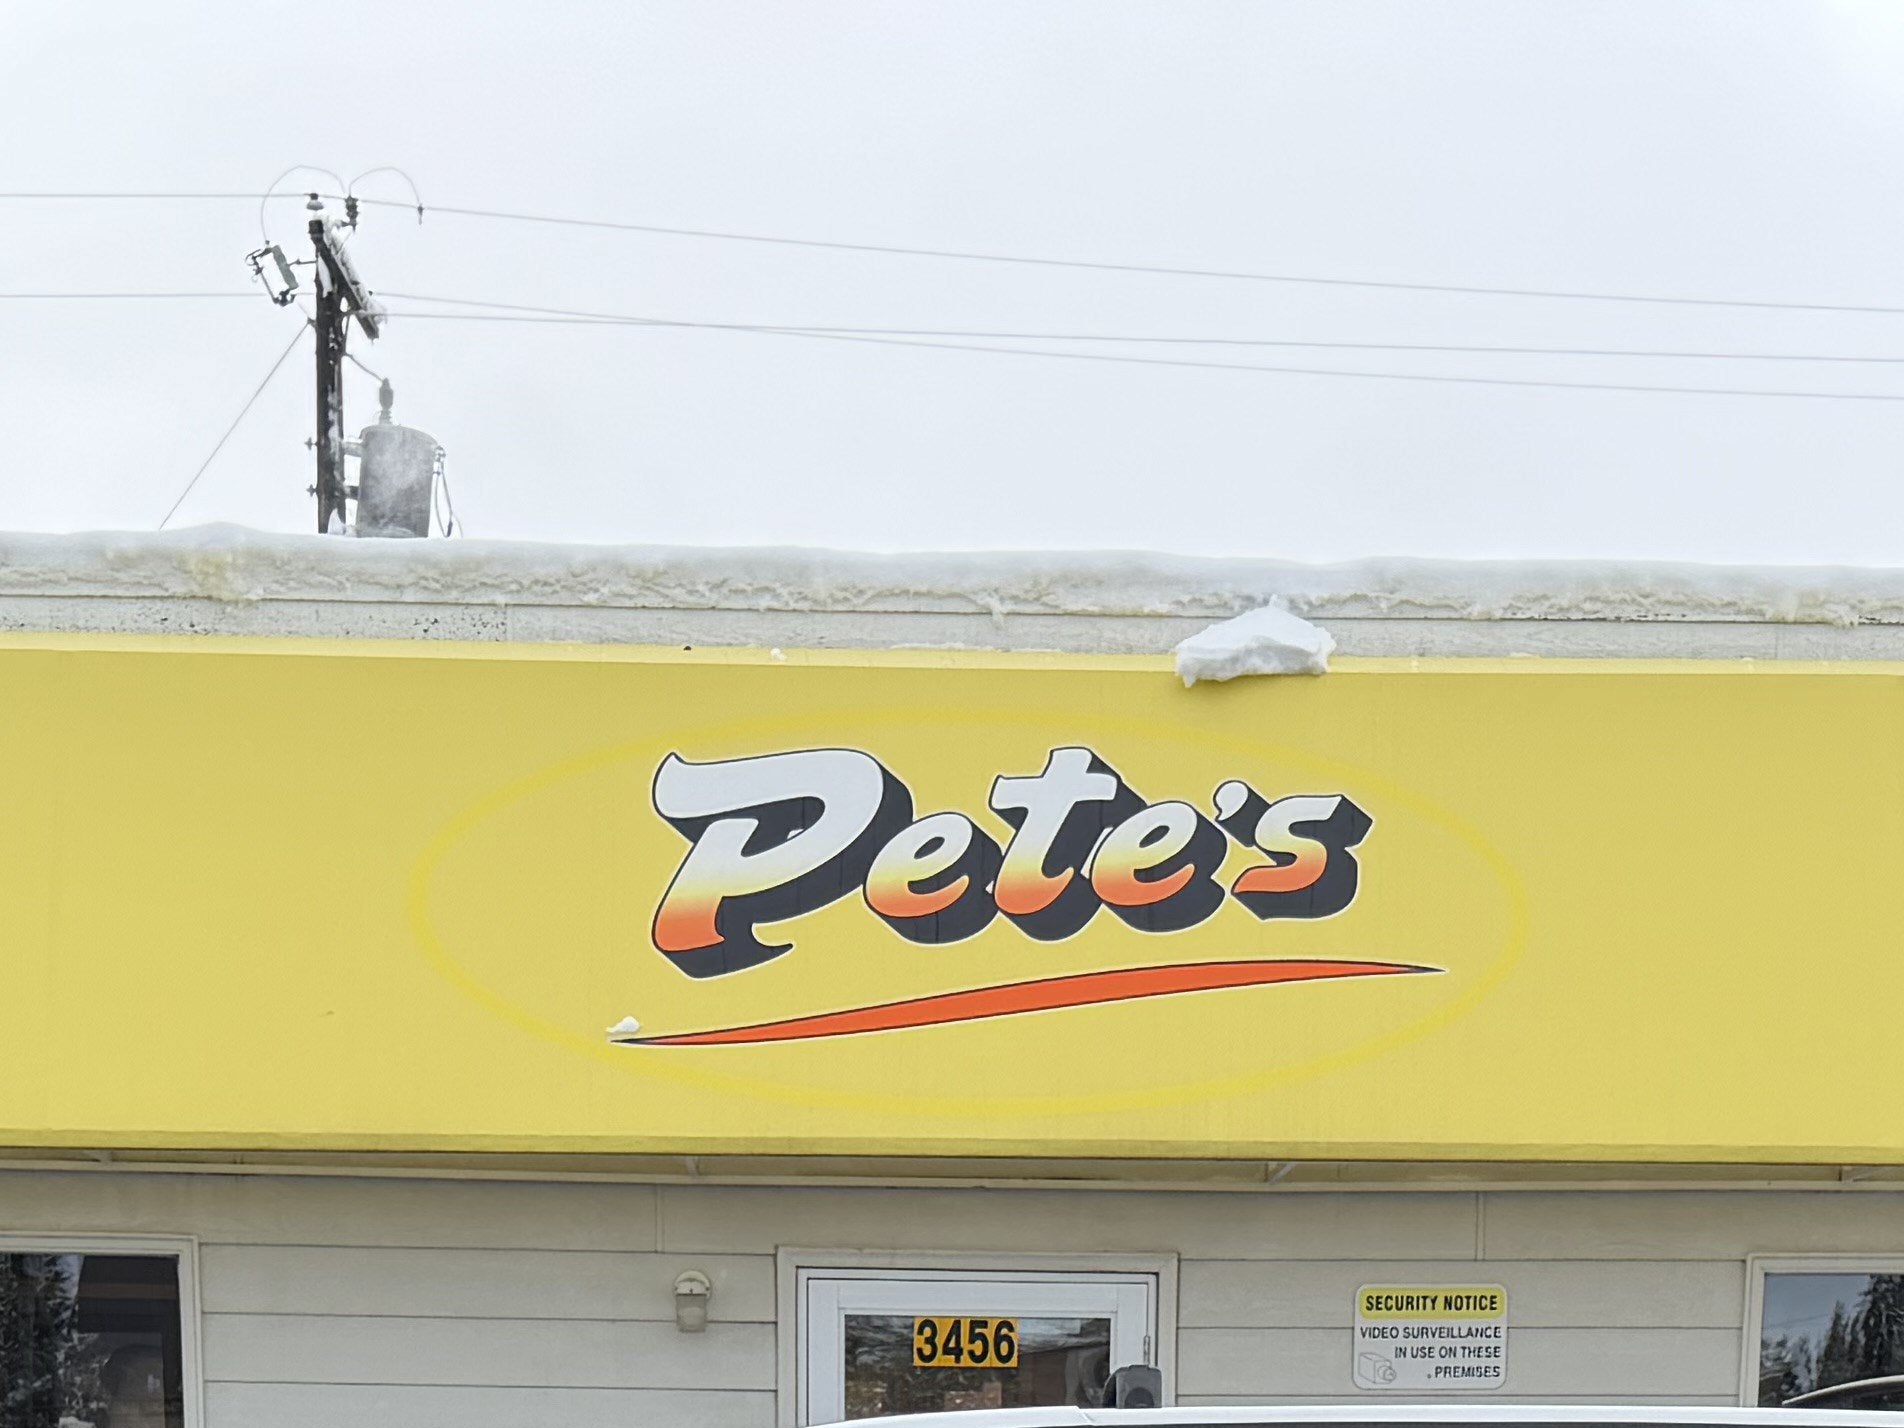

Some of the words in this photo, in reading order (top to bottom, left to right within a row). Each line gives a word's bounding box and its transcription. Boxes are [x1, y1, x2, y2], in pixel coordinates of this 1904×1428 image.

[651, 745, 1375, 978] Pete's
[1365, 1294, 1438, 1311] SECURITY
[1443, 1294, 1498, 1311] NOTICE
[1360, 1326, 1400, 1339] VIDEO
[1402, 1326, 1502, 1339] SURVEILLANCE
[915, 1318, 1016, 1365] 3456
[1394, 1346, 1407, 1359] IN
[1410, 1346, 1435, 1359] USE
[1438, 1346, 1457, 1359] ON
[1460, 1346, 1501, 1359] THESE
[1434, 1365, 1501, 1379] PREMISES
